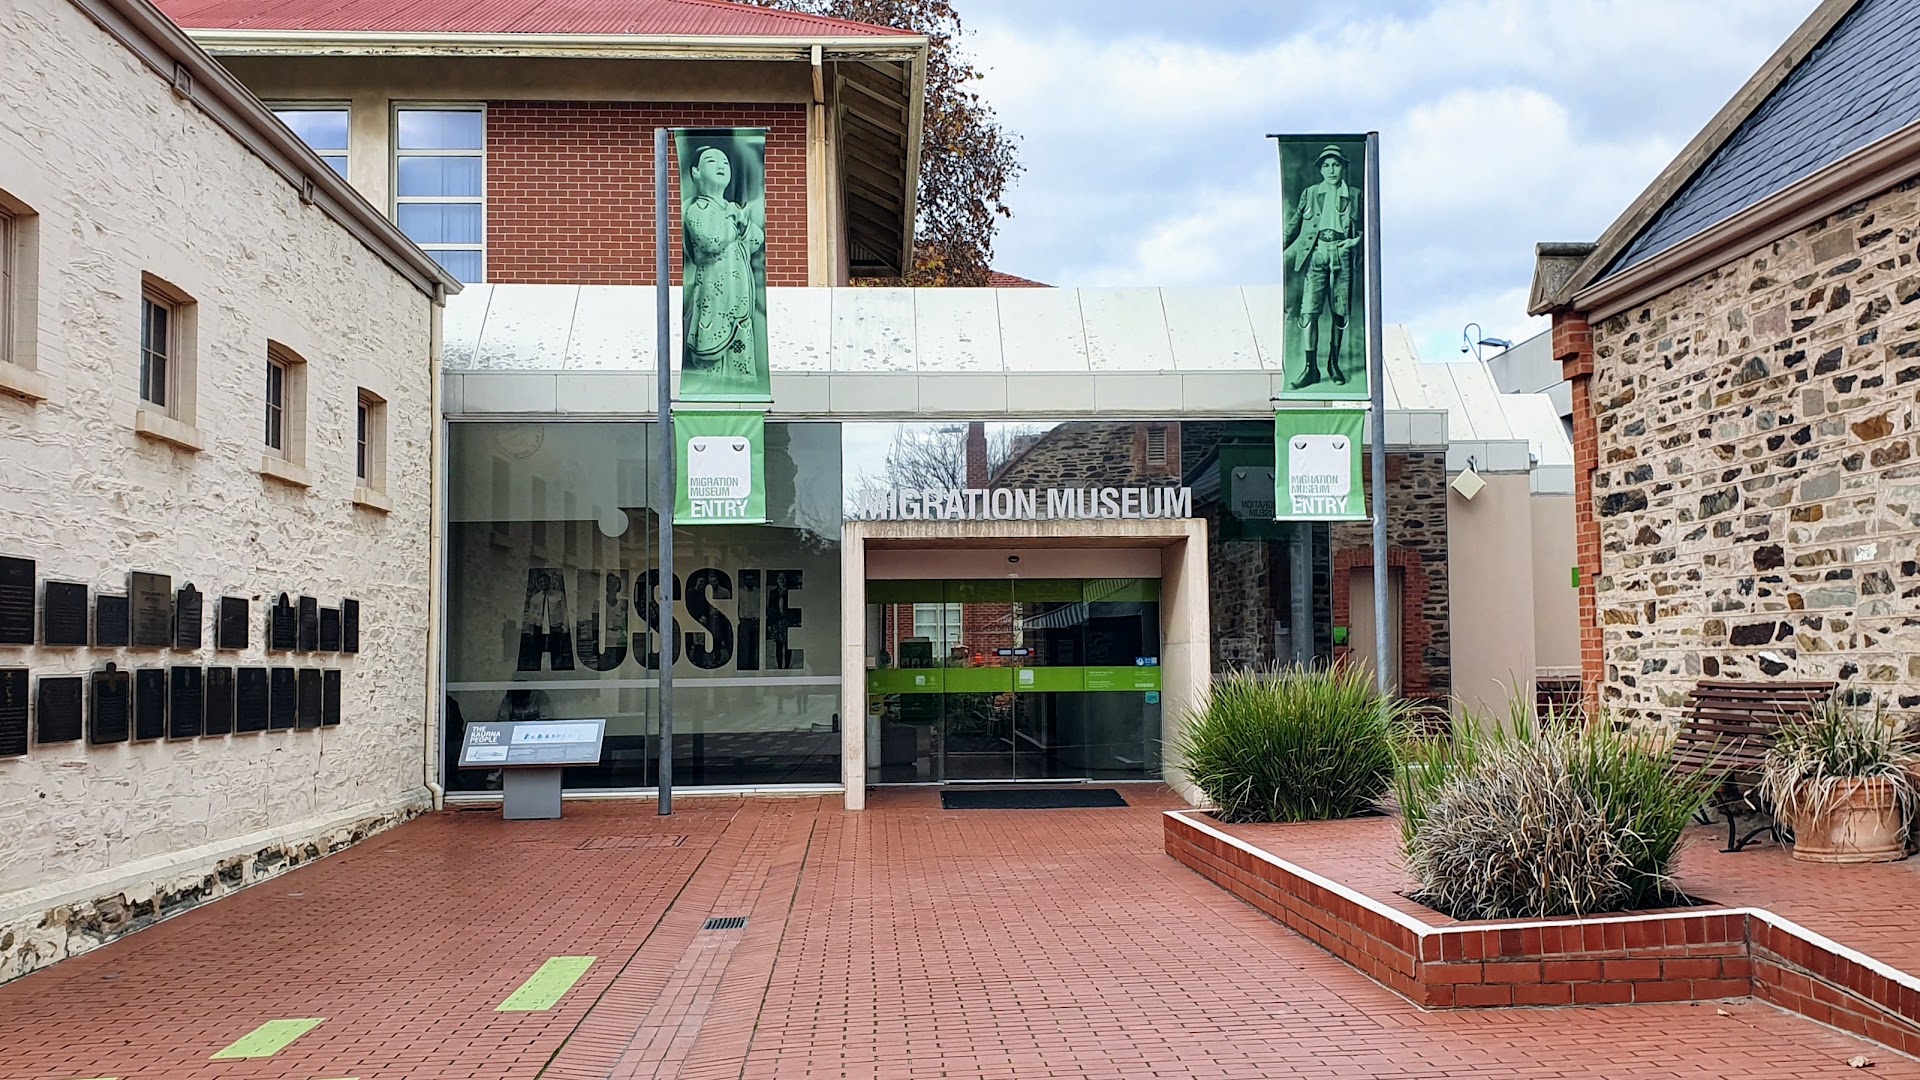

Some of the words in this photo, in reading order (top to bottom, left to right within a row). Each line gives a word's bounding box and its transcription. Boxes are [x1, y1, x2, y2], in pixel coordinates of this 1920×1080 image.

[690, 477, 739, 487] MIGRATION
[1291, 475, 1338, 484] MIGRATION
[690, 487, 730, 496] MUSEUM
[1291, 485, 1330, 494] MUSEUM
[690, 499, 748, 517] ENTRY
[859, 488, 1037, 520] MIGRATION
[1047, 486, 1192, 519] MUSEUM
[1292, 497, 1348, 514] ENTRY
[517, 567, 805, 672] AUSSIE
